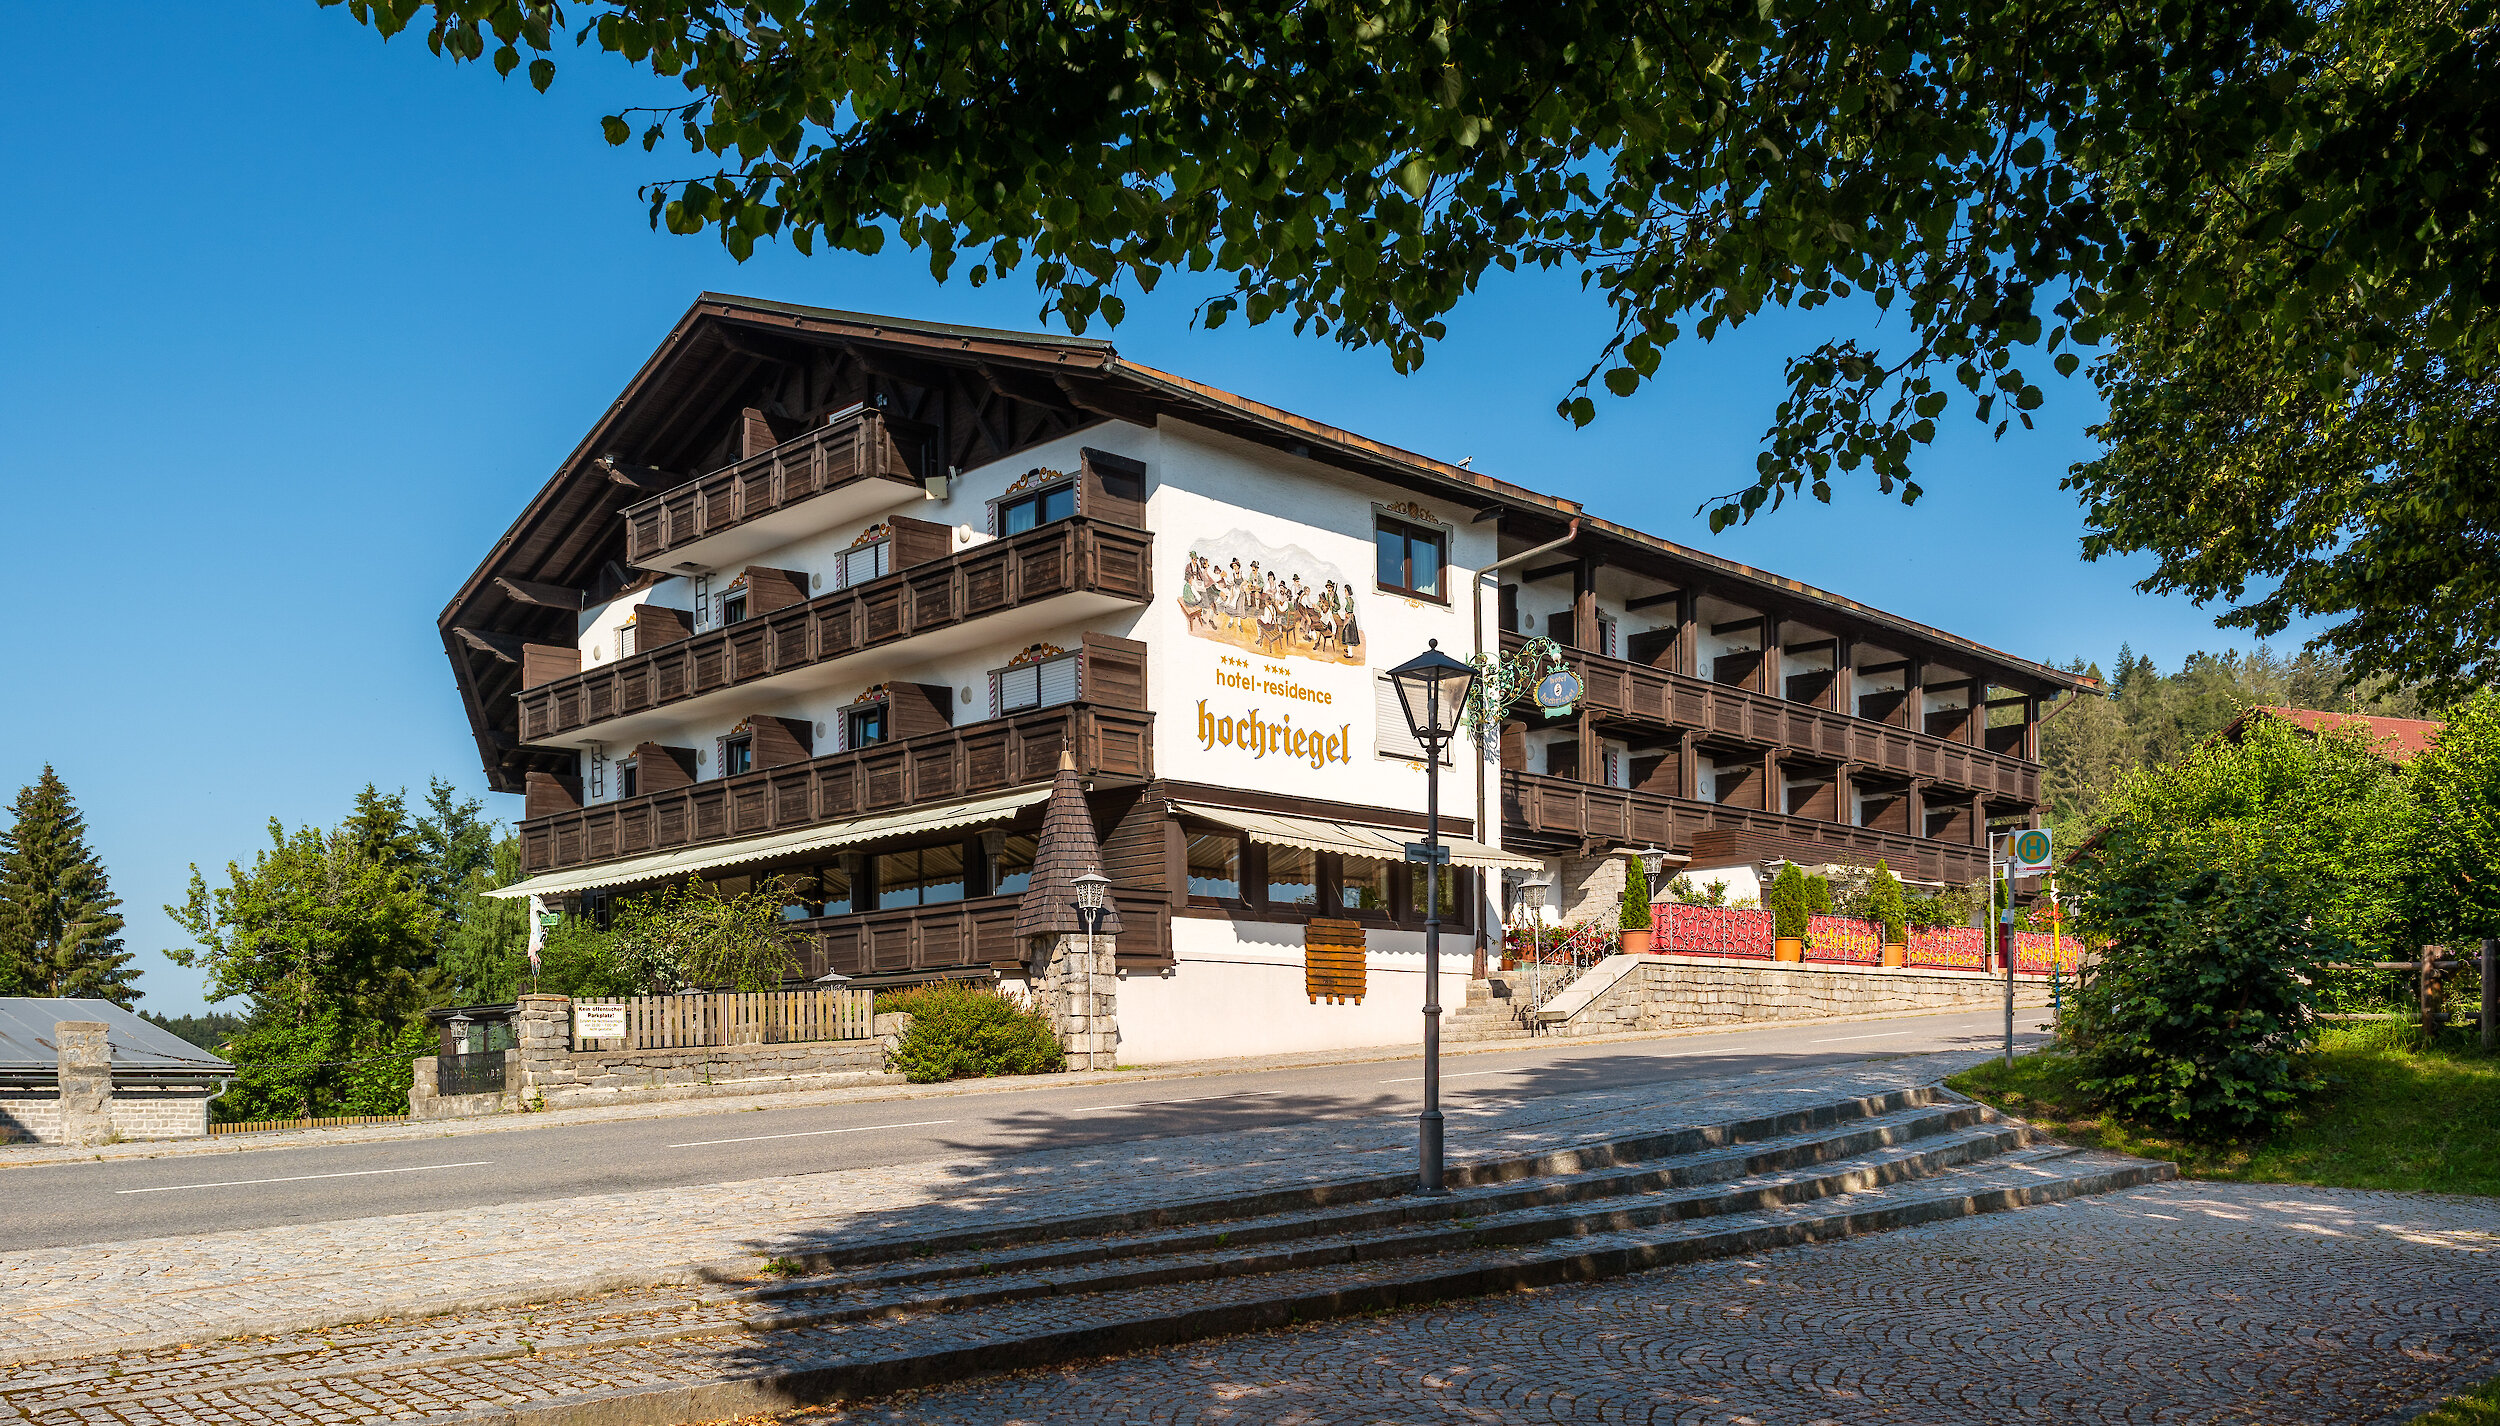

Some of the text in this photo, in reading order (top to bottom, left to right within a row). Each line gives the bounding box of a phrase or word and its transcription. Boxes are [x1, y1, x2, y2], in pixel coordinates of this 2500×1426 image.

[1550, 675, 1566, 684] hotel
[1541, 689, 1575, 704] hochriegel
[1195, 698, 1352, 770] hochriegel
[2025, 838, 2042, 857] H
